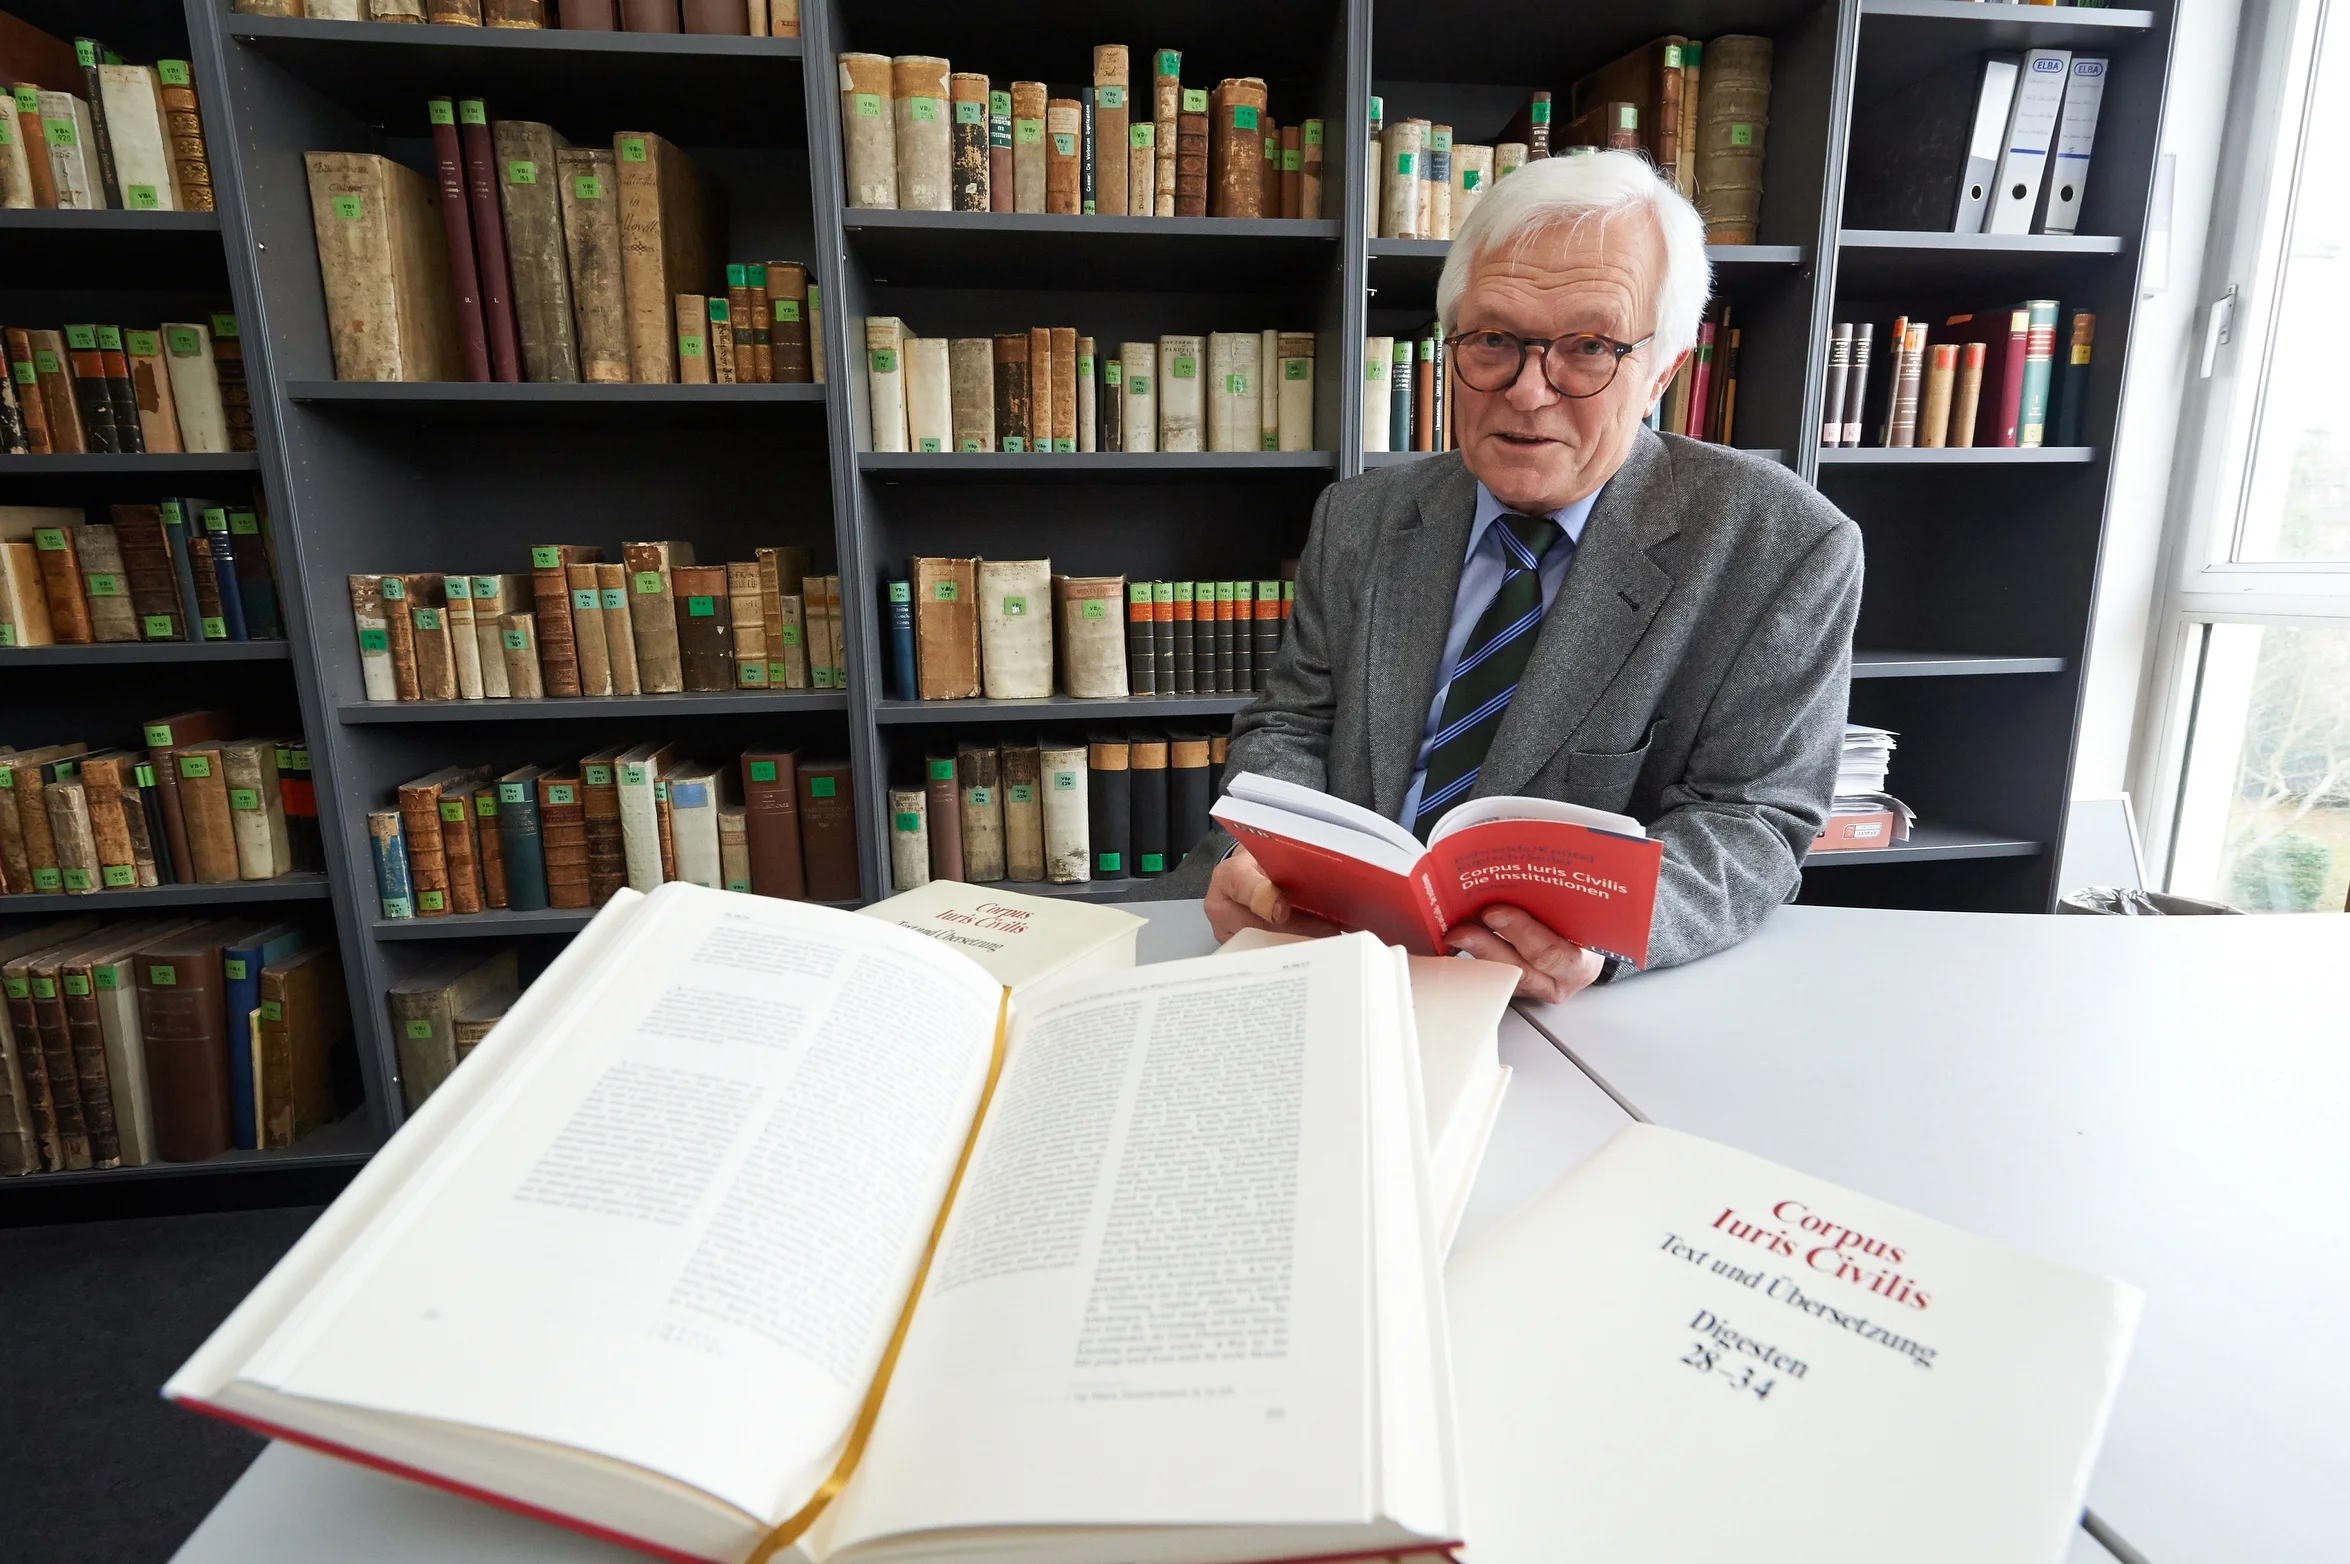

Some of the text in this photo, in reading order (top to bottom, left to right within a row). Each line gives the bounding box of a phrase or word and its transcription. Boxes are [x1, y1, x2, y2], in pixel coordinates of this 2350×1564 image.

[2037, 61, 2059, 71] ELBA
[2078, 65, 2099, 74] ELBA
[1459, 863, 1628, 894] Corpus Iuris Civilis
[1462, 876, 1489, 890] Die
[1495, 873, 1610, 899] Institutionen
[935, 909, 1028, 934] Iuris Civilis
[976, 903, 1034, 920] Corpus
[935, 929, 1004, 953] Übersetzung
[1772, 1200, 1907, 1265] Corpus
[1711, 1207, 1932, 1311] Iuris Civilis
[1658, 1231, 1939, 1371] Text und Übersetzung
[1689, 1307, 1810, 1381] Digesten
